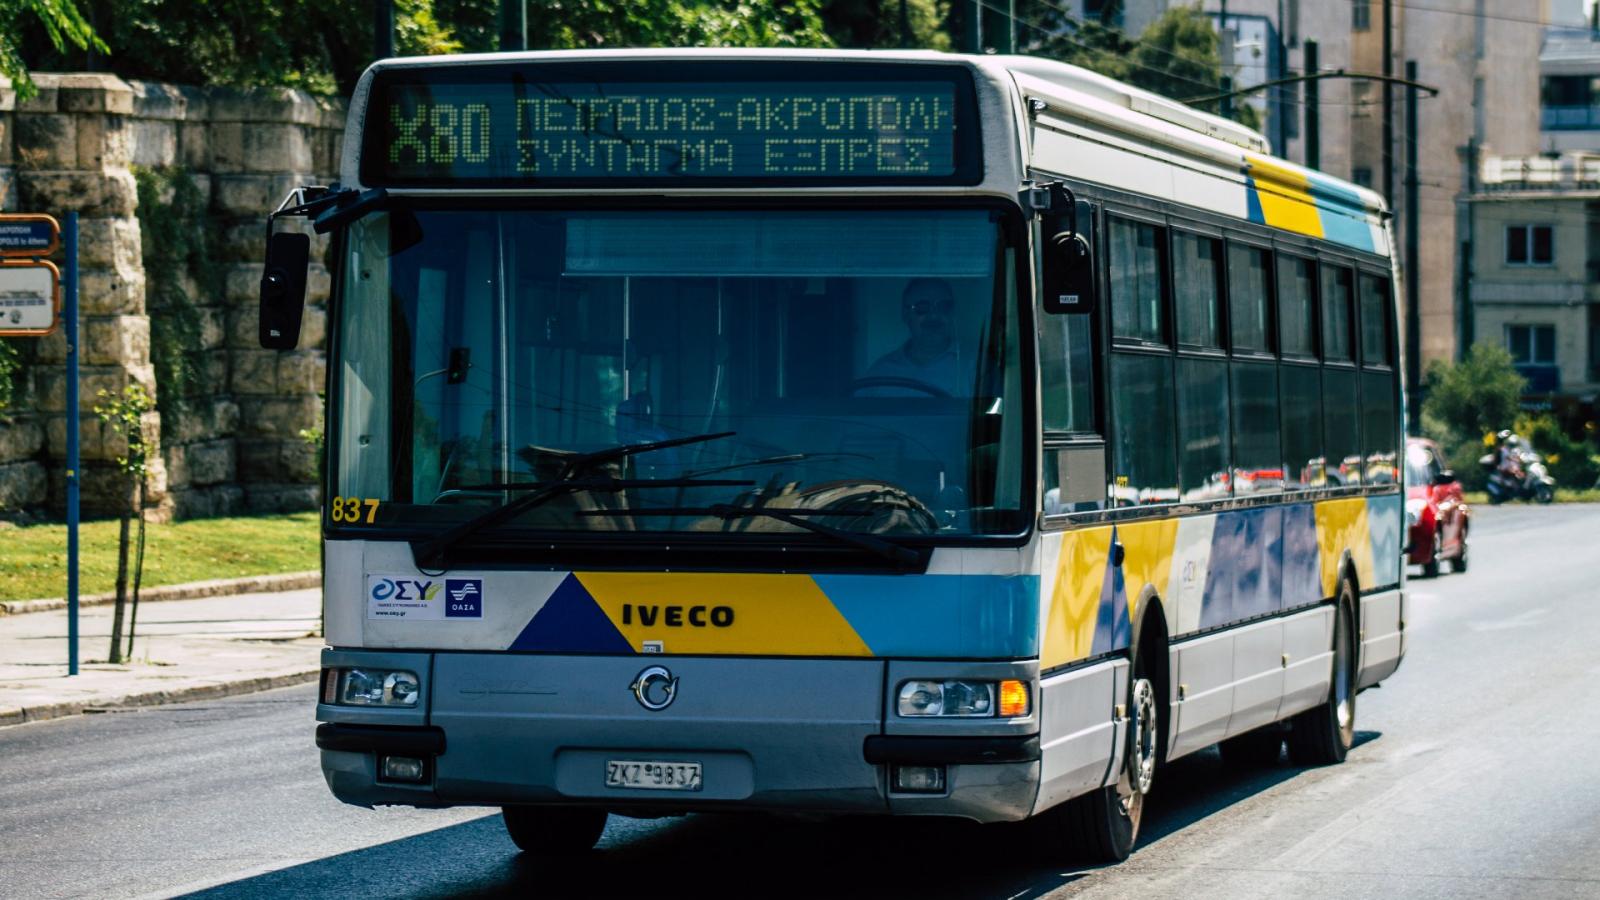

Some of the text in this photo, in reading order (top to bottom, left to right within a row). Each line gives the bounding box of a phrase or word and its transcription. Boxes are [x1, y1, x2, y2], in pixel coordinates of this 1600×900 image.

[389, 103, 490, 163] X80
[516, 138, 930, 172] ΣΥΝΤΑΓΜΑ ΕΞΠΡΕΣ
[332, 497, 380, 524] 837
[452, 603, 474, 611] ΟΑΣΑ
[622, 604, 735, 627] IVECO
